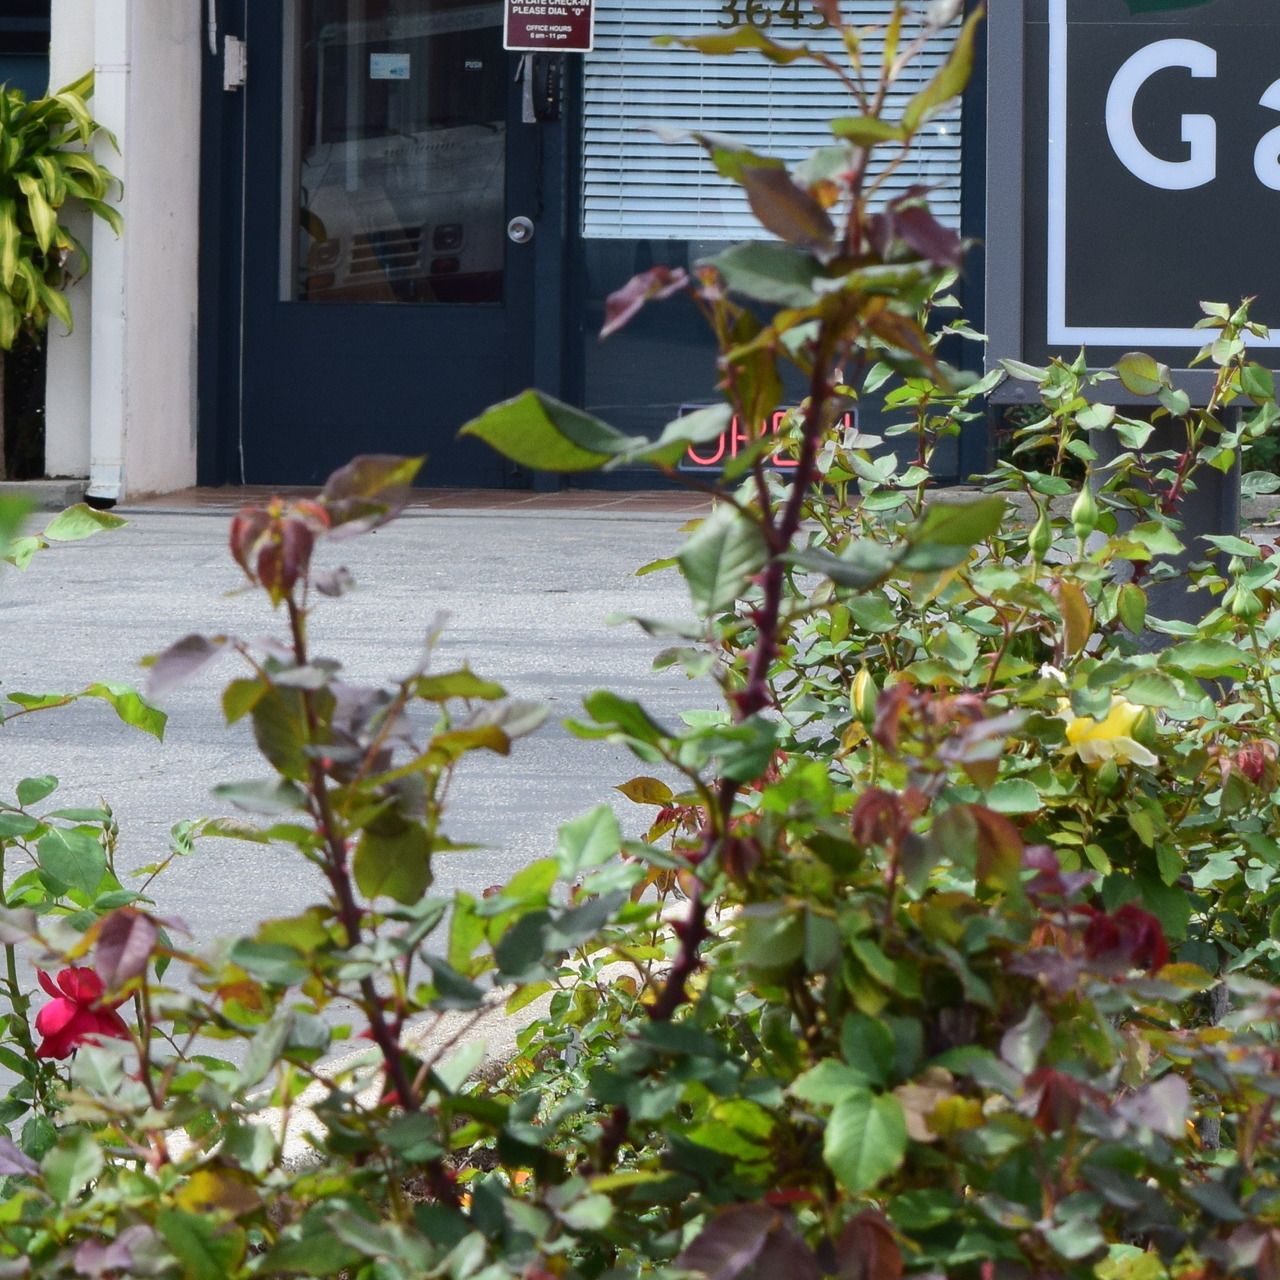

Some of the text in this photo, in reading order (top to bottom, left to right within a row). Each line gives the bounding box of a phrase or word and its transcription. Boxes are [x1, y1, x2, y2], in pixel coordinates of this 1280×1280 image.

[512, 6, 546, 15] PLEASE
[547, 7, 568, 16] DIAL
[526, 24, 549, 32] OFFICE
